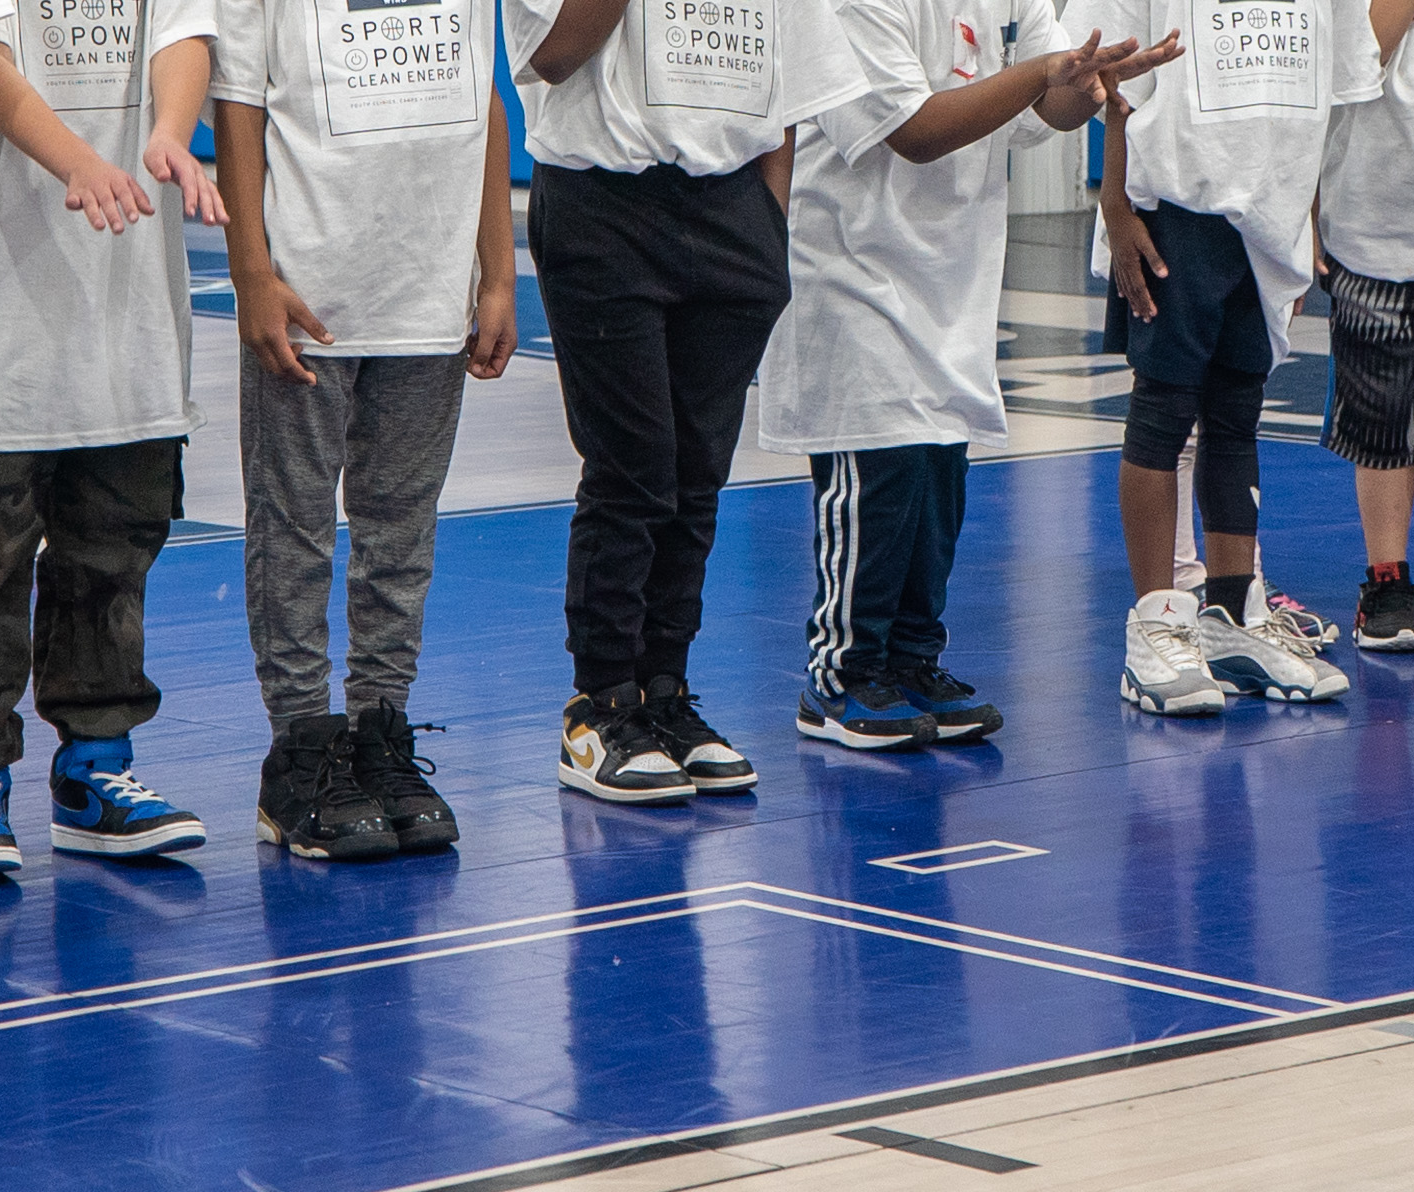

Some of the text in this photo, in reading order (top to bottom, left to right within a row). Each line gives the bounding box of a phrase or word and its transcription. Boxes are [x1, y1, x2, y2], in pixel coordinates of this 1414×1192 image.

[665, 1, 764, 30] SPORTS
[1212, 8, 1309, 30] SPORTS
[72, 26, 136, 46] POW
[341, 14, 460, 43] SPORTS
[374, 42, 460, 67] POWER
[691, 30, 765, 57] POWER
[1240, 34, 1309, 54] POWER
[45, 52, 98, 66] CLEAN
[667, 52, 763, 74] CLEAN ENERGY
[1217, 56, 1309, 70] CLEAN ENERGY
[347, 68, 460, 89] CLEAN ENERGY
